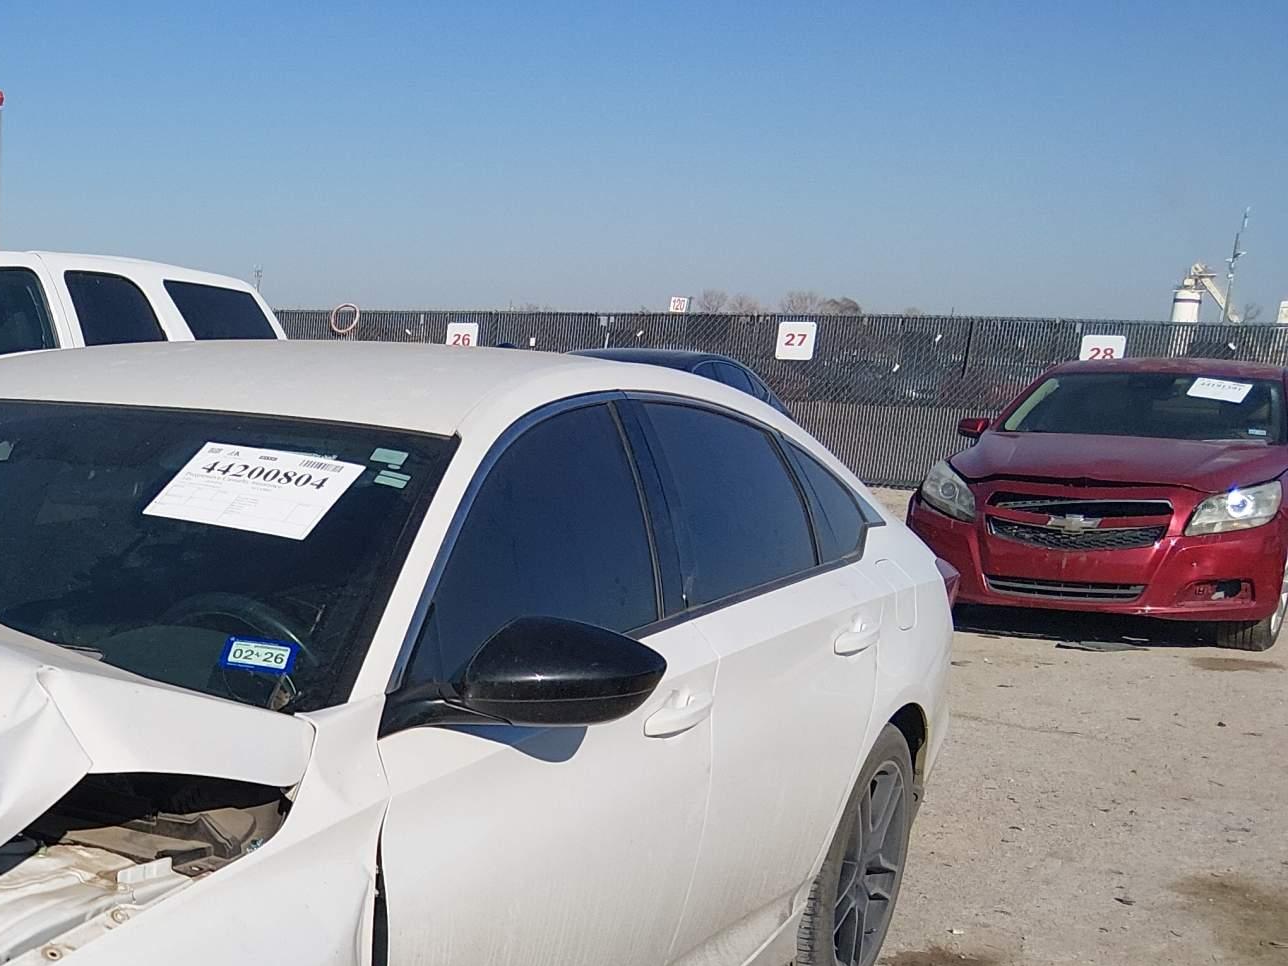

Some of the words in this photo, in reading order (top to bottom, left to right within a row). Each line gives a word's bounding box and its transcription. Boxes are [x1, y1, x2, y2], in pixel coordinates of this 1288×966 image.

[672, 298, 686, 311] 120
[452, 333, 471, 346] 26
[784, 333, 808, 347] 27
[1088, 347, 1114, 360] 28
[201, 460, 330, 490] 44200804
[232, 648, 255, 660] 02
[262, 651, 286, 664] 26
